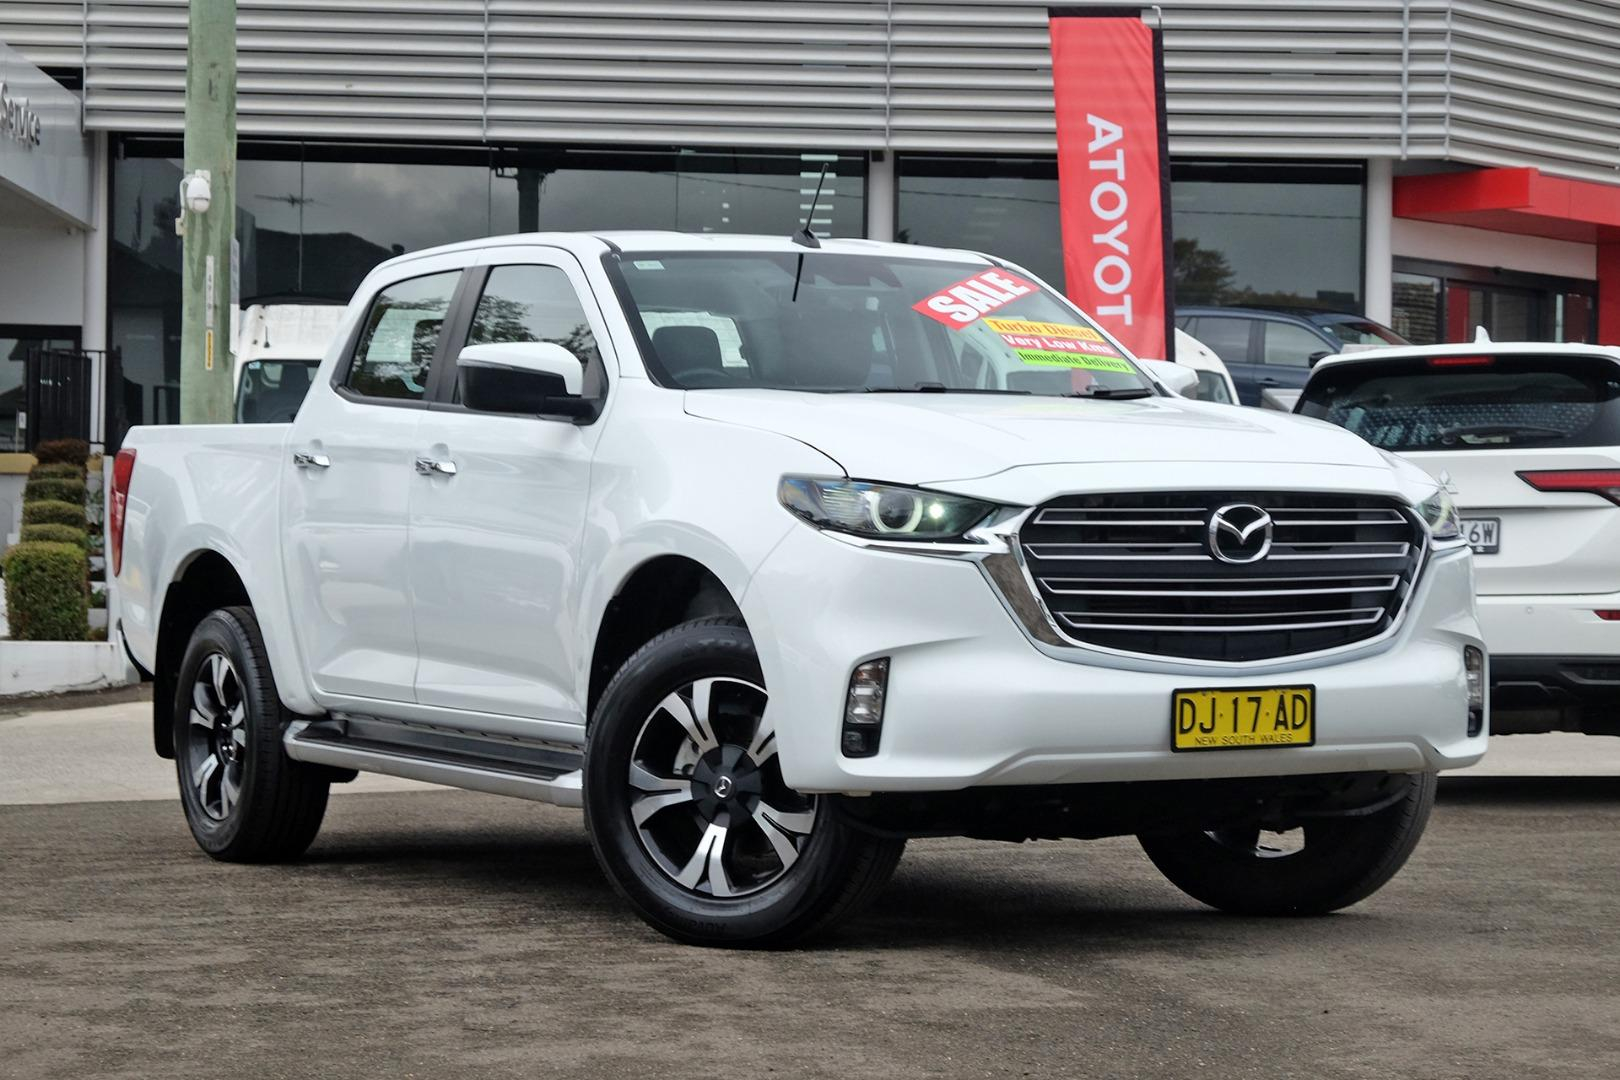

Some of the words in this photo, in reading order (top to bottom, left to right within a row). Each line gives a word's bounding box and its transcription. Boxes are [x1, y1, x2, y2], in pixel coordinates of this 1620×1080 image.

[927, 271, 1031, 322] SALE
[990, 320, 1041, 333] Turbo
[1045, 323, 1097, 339] Diesel
[1001, 334, 1042, 349] Very
[1043, 336, 1076, 351] Low
[1018, 351, 1082, 365] Immediate
[1082, 355, 1131, 371] Delivery
[1194, 736, 1217, 746] NEW
[1222, 734, 1255, 745] SOUTH
[1260, 733, 1293, 743] WALES
